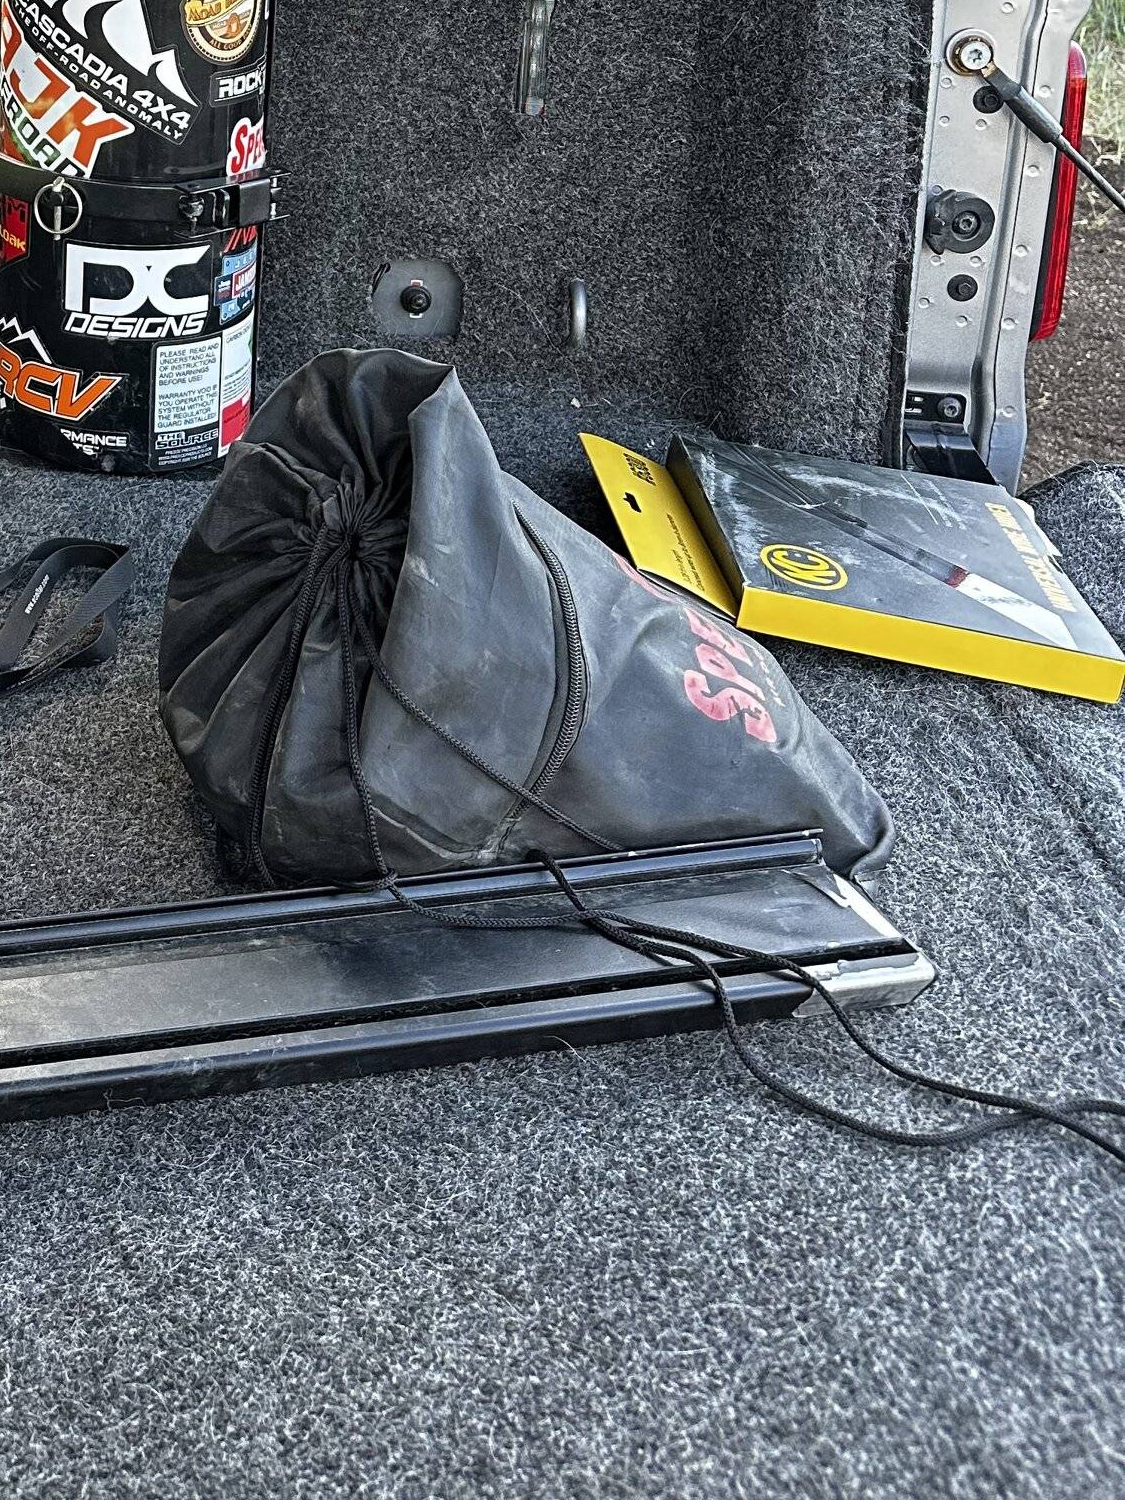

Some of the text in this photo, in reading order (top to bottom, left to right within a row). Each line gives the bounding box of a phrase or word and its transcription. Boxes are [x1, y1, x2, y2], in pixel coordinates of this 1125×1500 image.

[14, 2, 32, 25] THE
[103, 89, 183, 140] ANOMALY
[132, 89, 191, 130] 4X4
[65, 311, 208, 338] DESIGNS
[159, 342, 220, 358] PLEASE READ AND
[159, 350, 216, 365] UNDERSTAND ALL
[170, 357, 217, 371] INSTRUCTIONS
[159, 366, 210, 379] AND WARNINGS
[158, 377, 187, 386] BEFORE
[158, 390, 196, 400] WARRANTY
[197, 386, 212, 395] VOID
[158, 399, 173, 407] YOU
[174, 394, 205, 405] OPERATE
[158, 399, 215, 415] SYSTEM WITHOUT
[158, 413, 172, 421] THE
[172, 406, 212, 420] REGULATOR
[157, 419, 183, 429] GUARD
[155, 428, 219, 450] SOURCE
